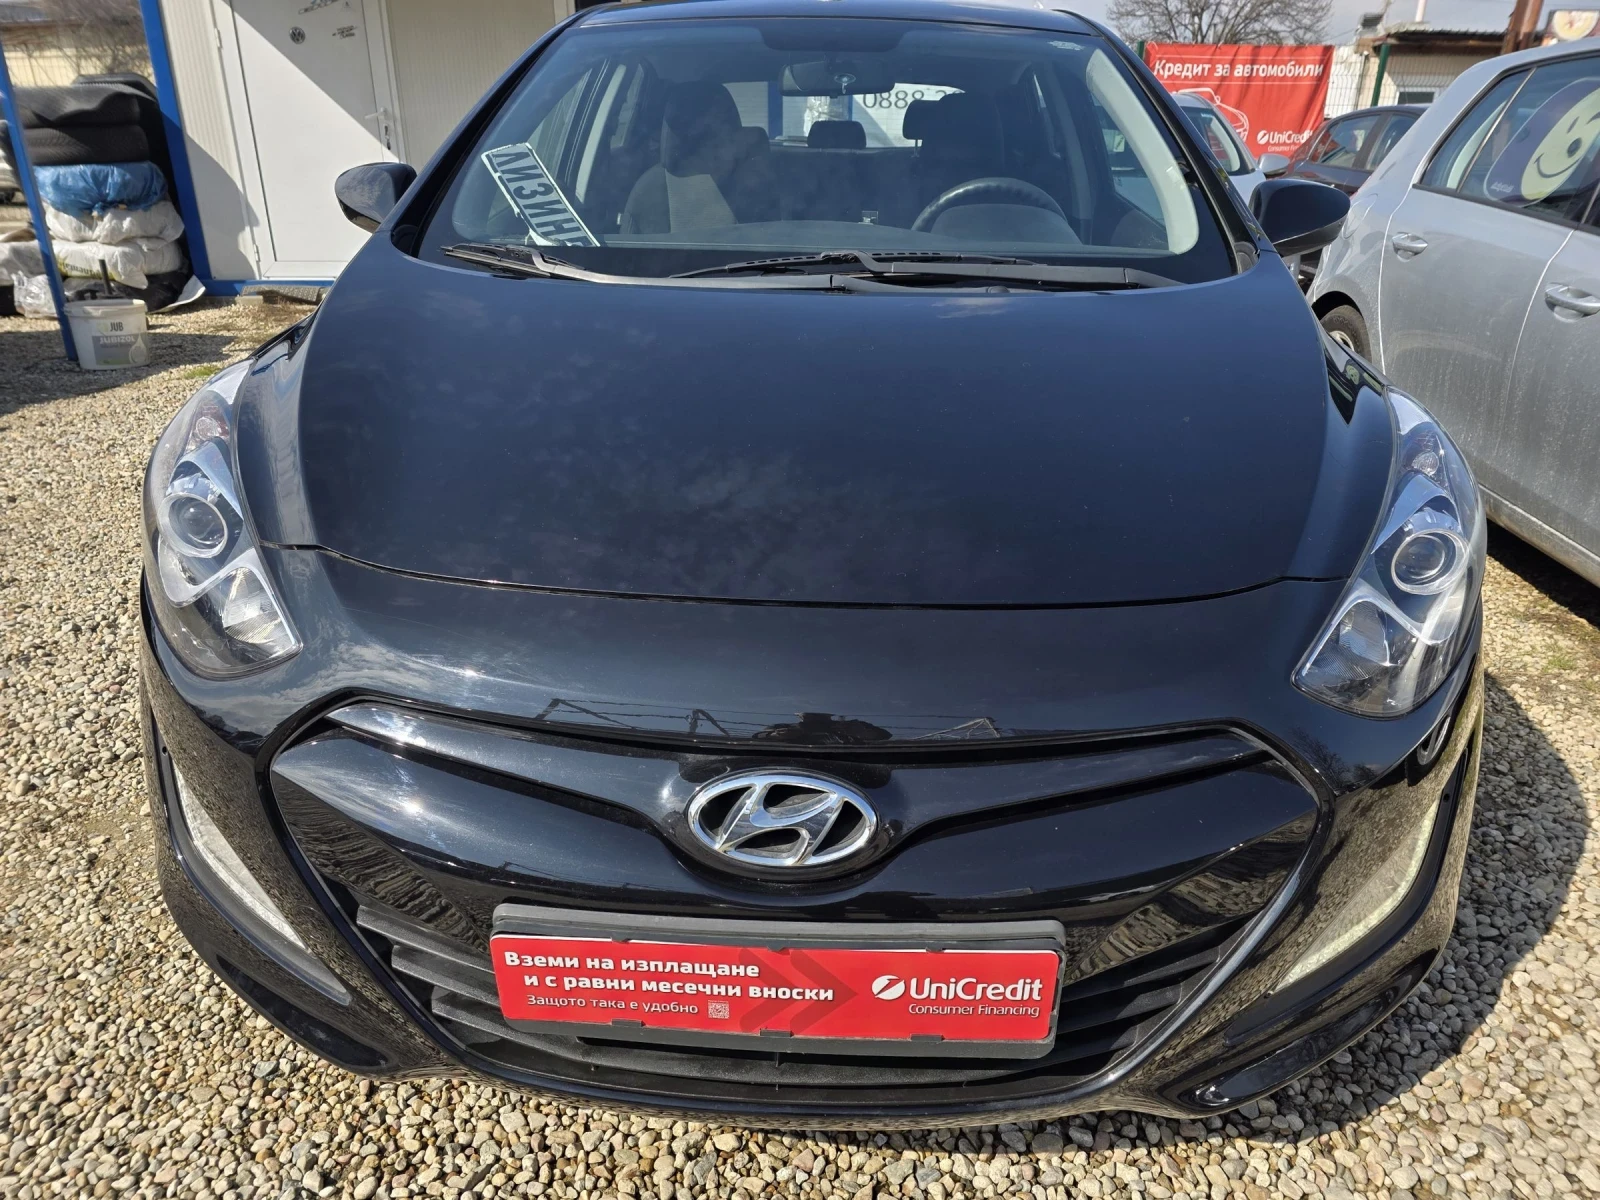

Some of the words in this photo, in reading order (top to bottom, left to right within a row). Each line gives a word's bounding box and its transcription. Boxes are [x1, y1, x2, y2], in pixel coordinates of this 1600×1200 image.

[1154, 60, 1211, 79] Кредит
[1214, 64, 1230, 77] за
[1234, 61, 1324, 77] автомобили
[110, 321, 124, 332] JUB
[504, 951, 579, 968] Вземи
[586, 957, 615, 970] на
[621, 959, 760, 978] изплащане
[524, 975, 538, 986] и
[545, 975, 557, 987] с
[563, 976, 635, 991] равни
[641, 980, 742, 997] месечни
[749, 986, 834, 1001] вноски
[909, 977, 1043, 1000] UniCredit
[527, 994, 586, 1008] Защото
[589, 999, 625, 1009] така
[630, 1001, 638, 1010] е
[643, 1001, 698, 1014] удобно
[908, 1003, 974, 1015] Consumer
[978, 1004, 1040, 1017] Financing
